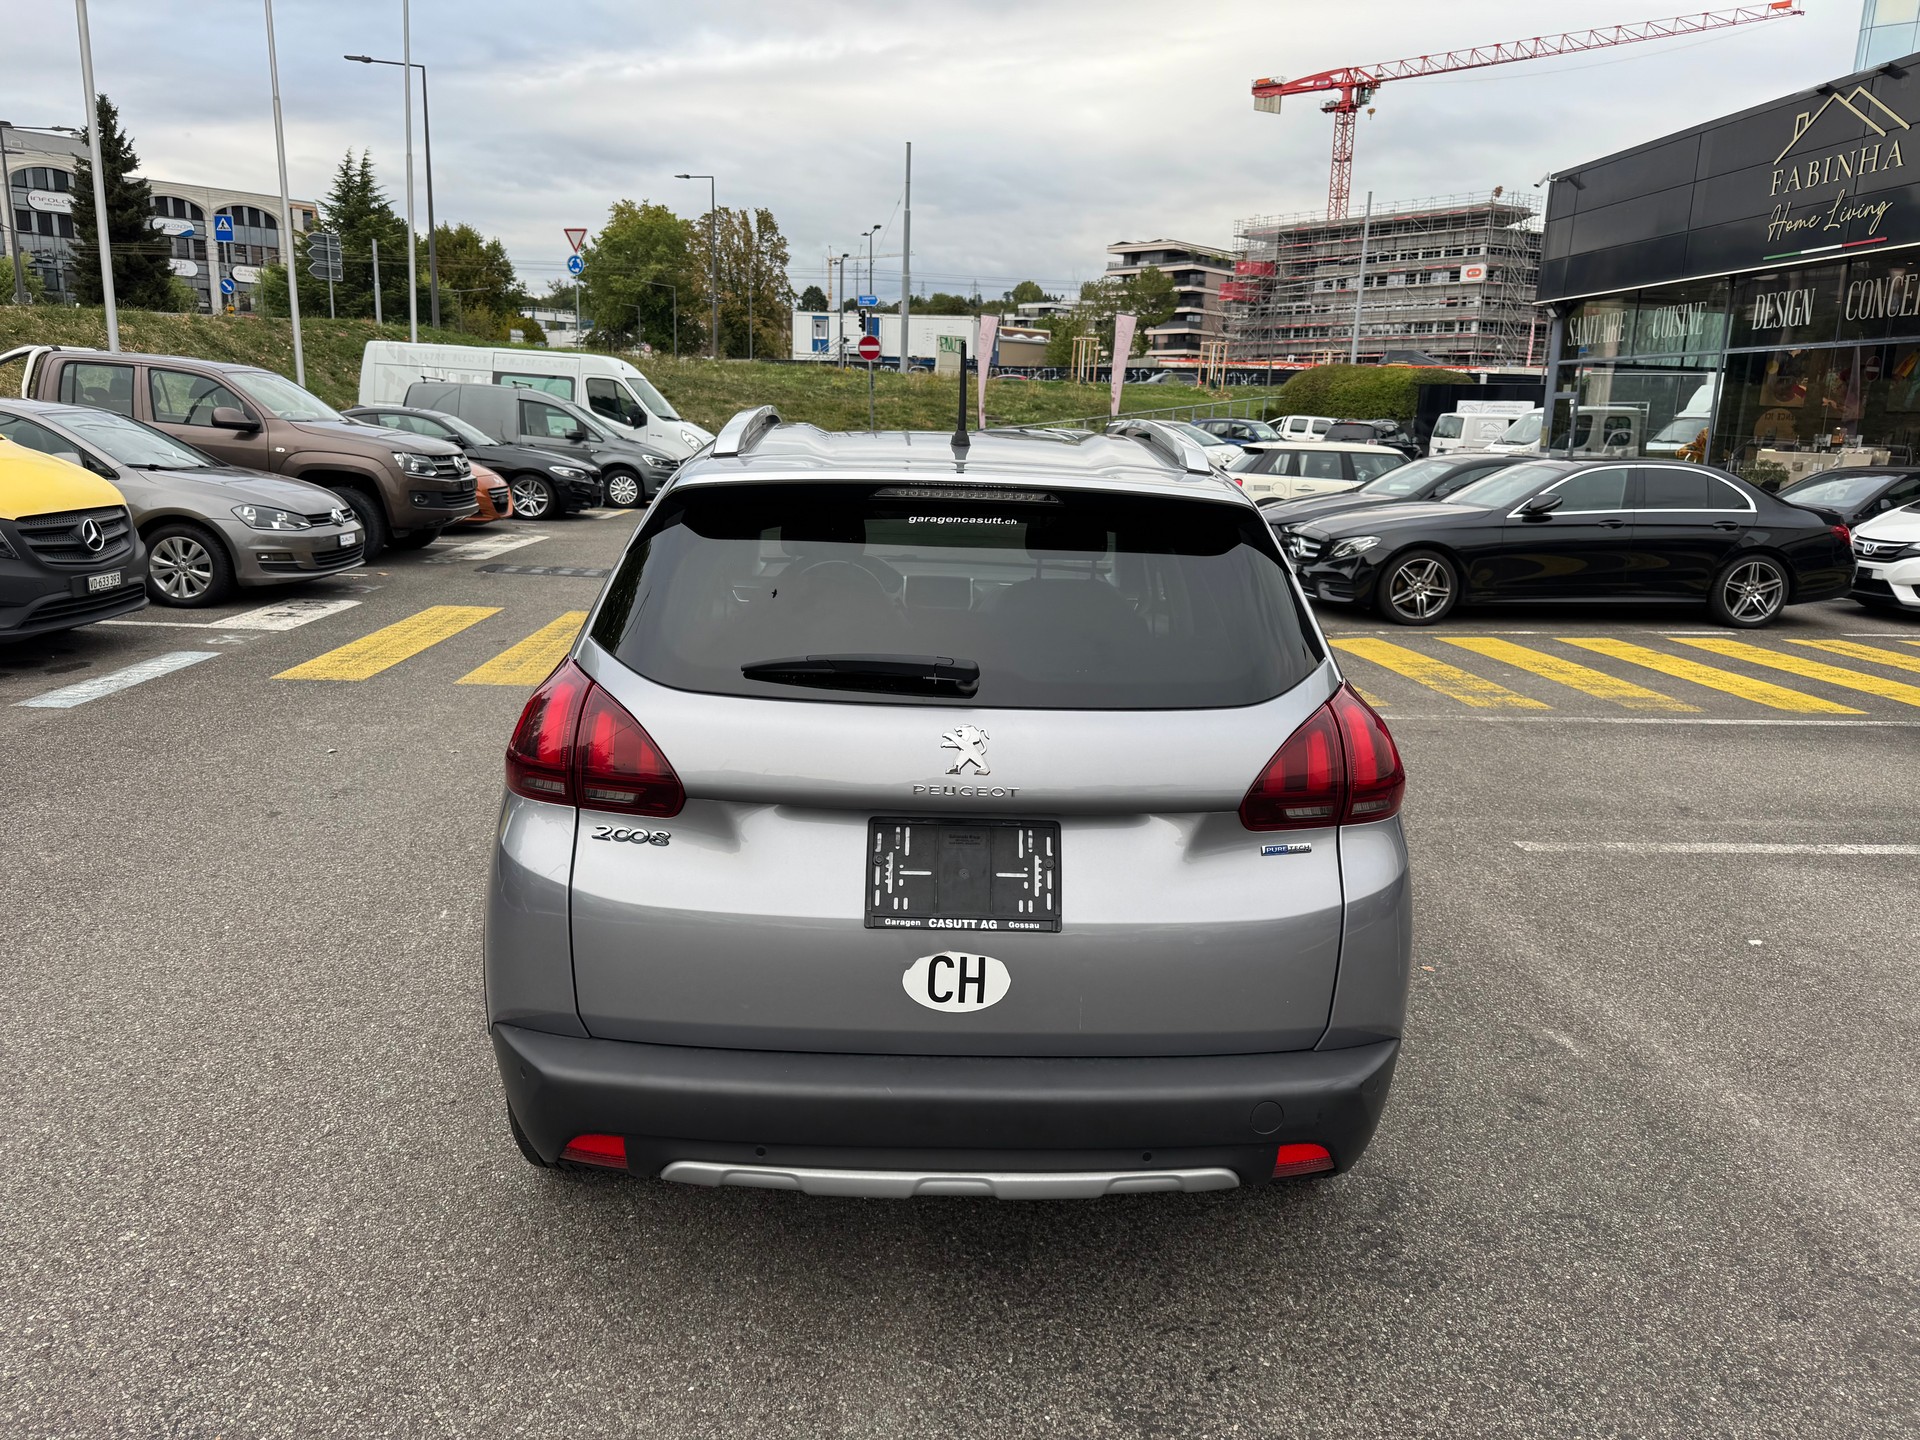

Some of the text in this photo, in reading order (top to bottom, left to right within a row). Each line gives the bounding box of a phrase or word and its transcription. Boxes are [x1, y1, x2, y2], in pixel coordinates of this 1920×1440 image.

[1769, 139, 1904, 197] FABINHA
[1768, 189, 1893, 242] Home Living
[1652, 301, 1707, 340] CUISINE
[1752, 287, 1816, 331] DESIGN
[1567, 311, 1628, 347] SANITAIRE
[908, 516, 1018, 525] garagencasutt.ch
[913, 784, 1020, 797] PEUGEOT
[591, 825, 672, 846] 2008
[884, 918, 1040, 929] Garagen CASUTT AG Gossau
[927, 955, 986, 1003] CH
